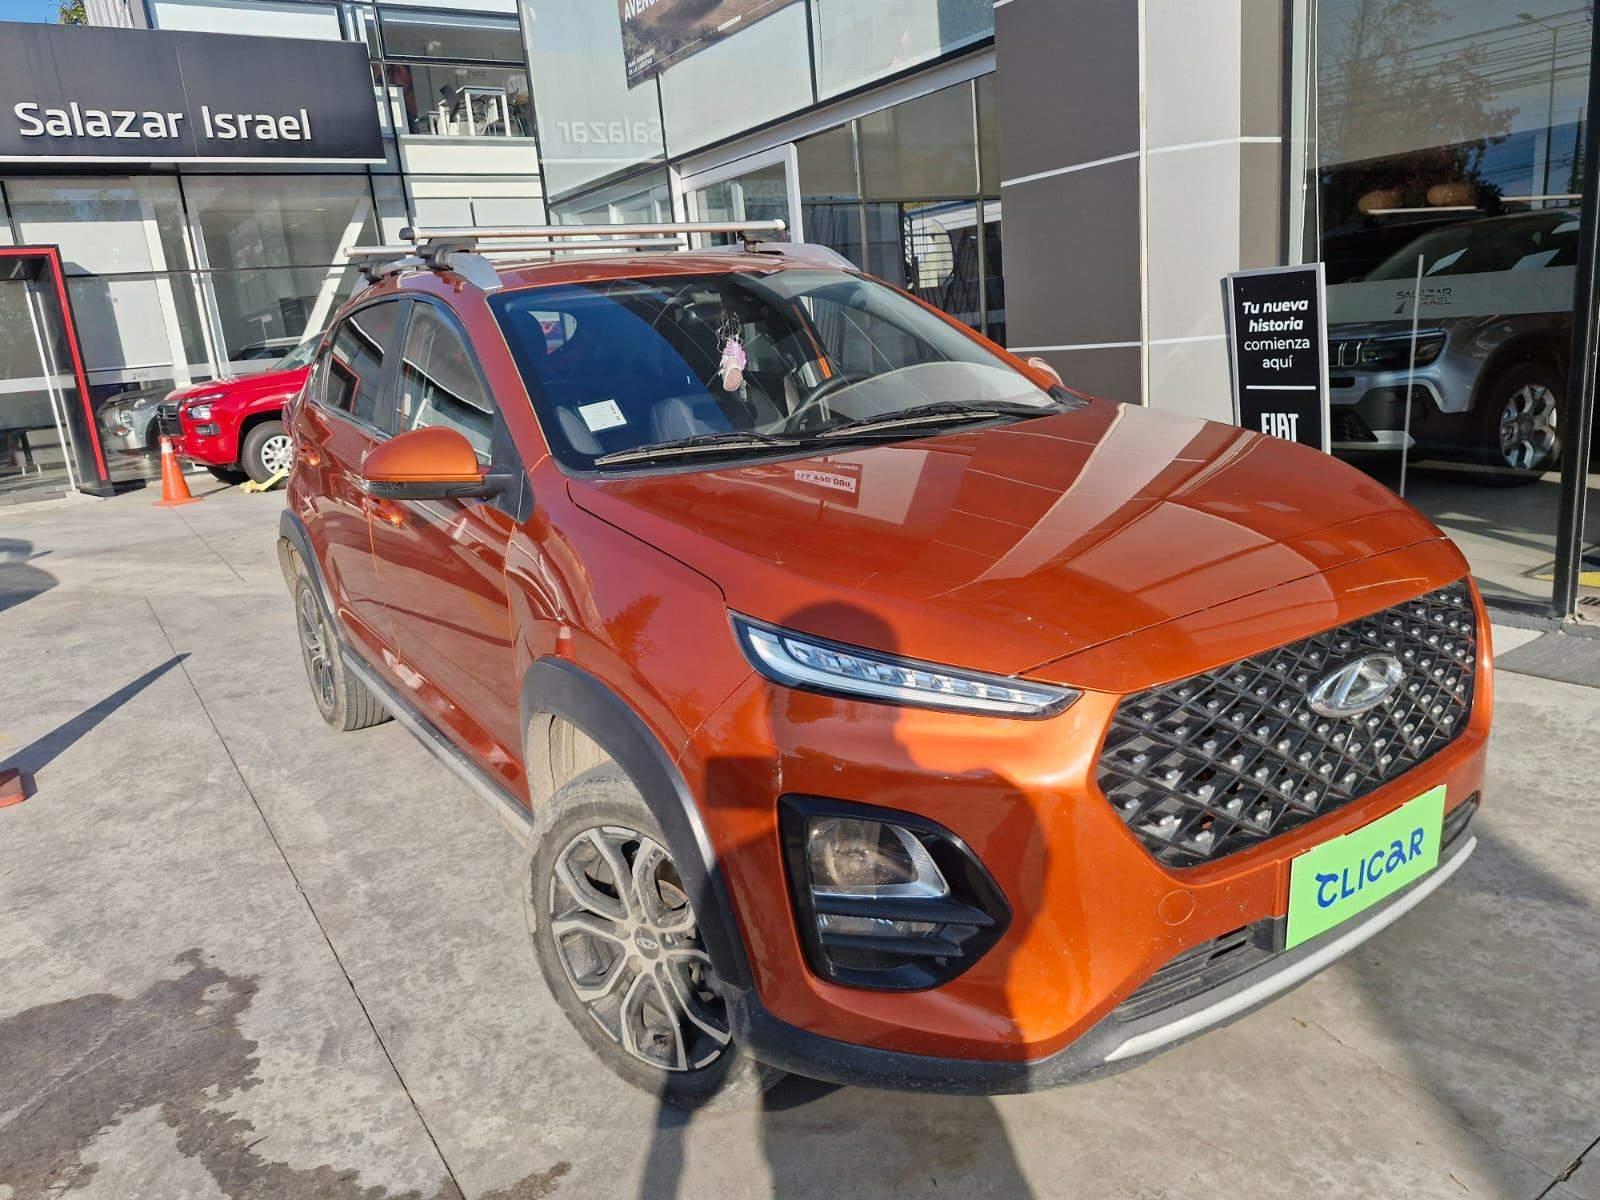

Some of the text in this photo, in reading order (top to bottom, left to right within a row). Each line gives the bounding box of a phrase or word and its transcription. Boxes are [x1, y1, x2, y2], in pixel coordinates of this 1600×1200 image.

[14, 102, 312, 140] Salazar Israel
[1242, 300, 1309, 315] Tu nueva
[1248, 316, 1304, 333] historia
[1244, 336, 1311, 351] comienza
[1262, 354, 1294, 371] aquí
[1261, 412, 1299, 443] FIAT
